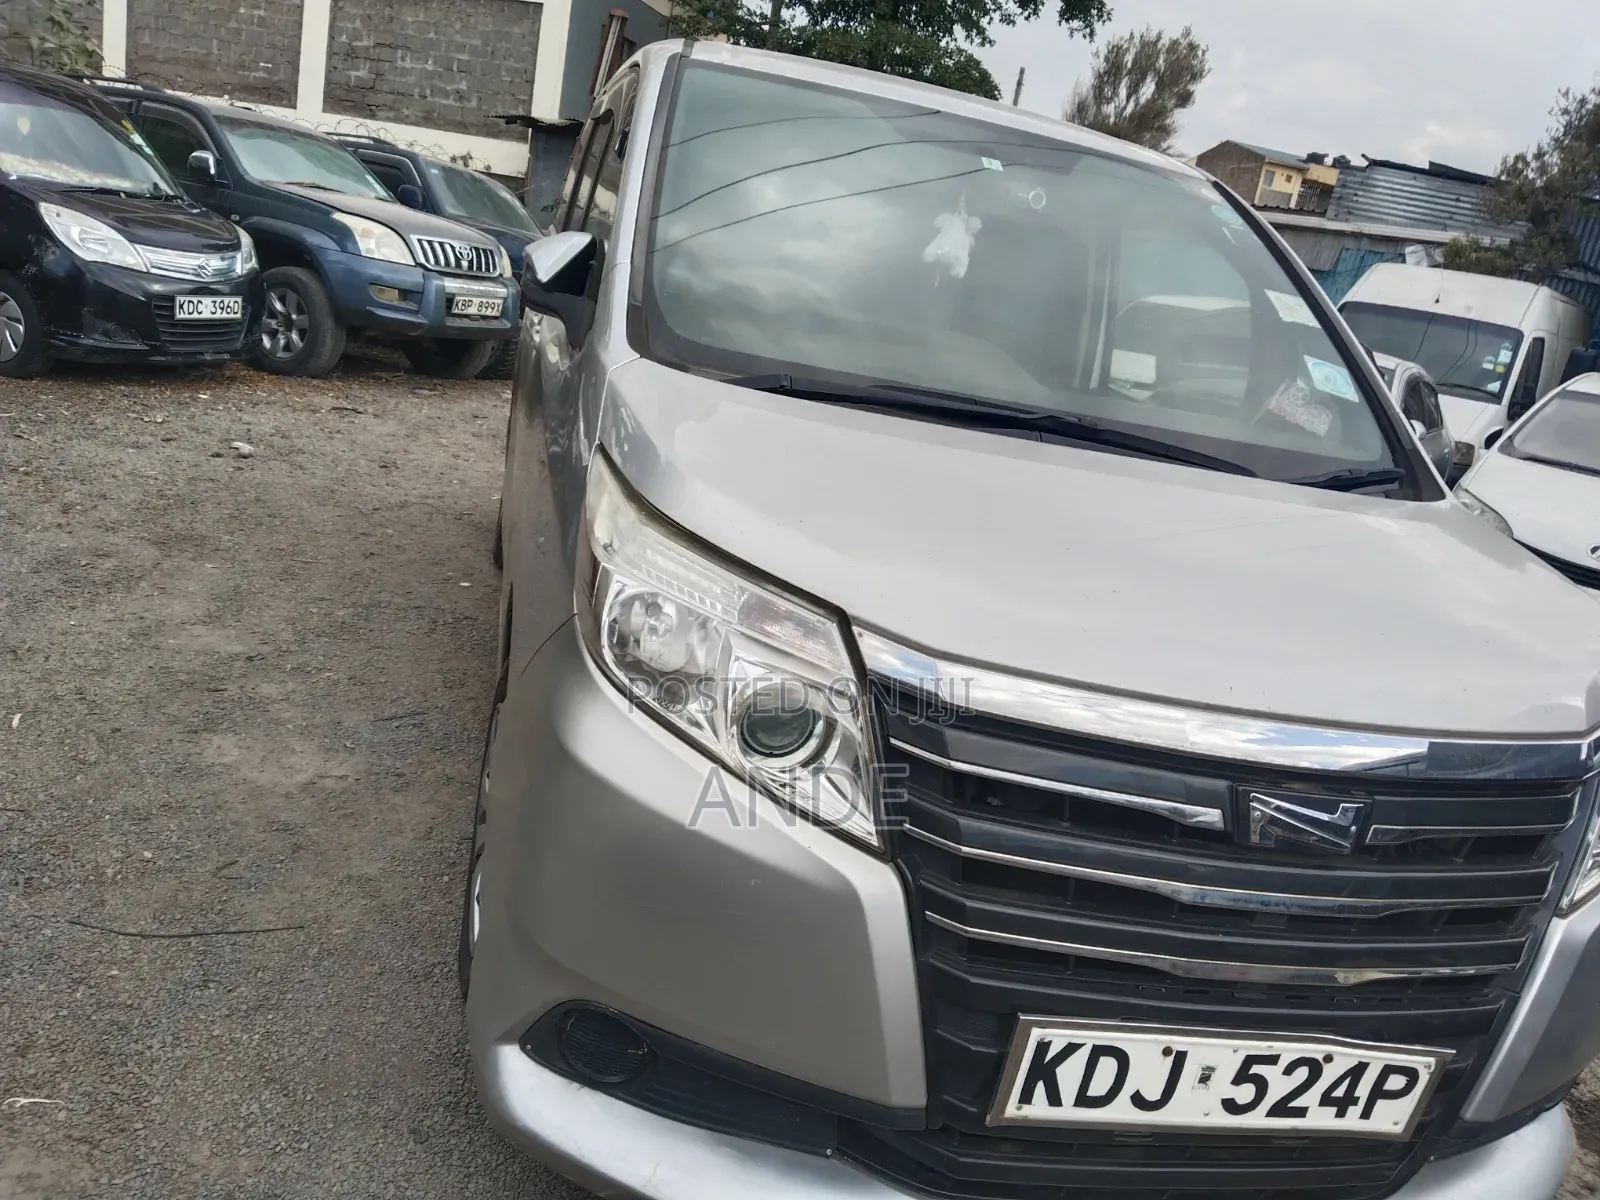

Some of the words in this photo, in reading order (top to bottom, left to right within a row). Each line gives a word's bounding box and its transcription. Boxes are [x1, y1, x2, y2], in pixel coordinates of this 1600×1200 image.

[178, 299, 203, 316] KDC
[210, 299, 240, 316] 396D
[453, 298, 474, 312] KBP
[476, 300, 502, 314] 899X
[1017, 1039, 1187, 1113] KDJ
[1220, 1053, 1421, 1121] 524P
